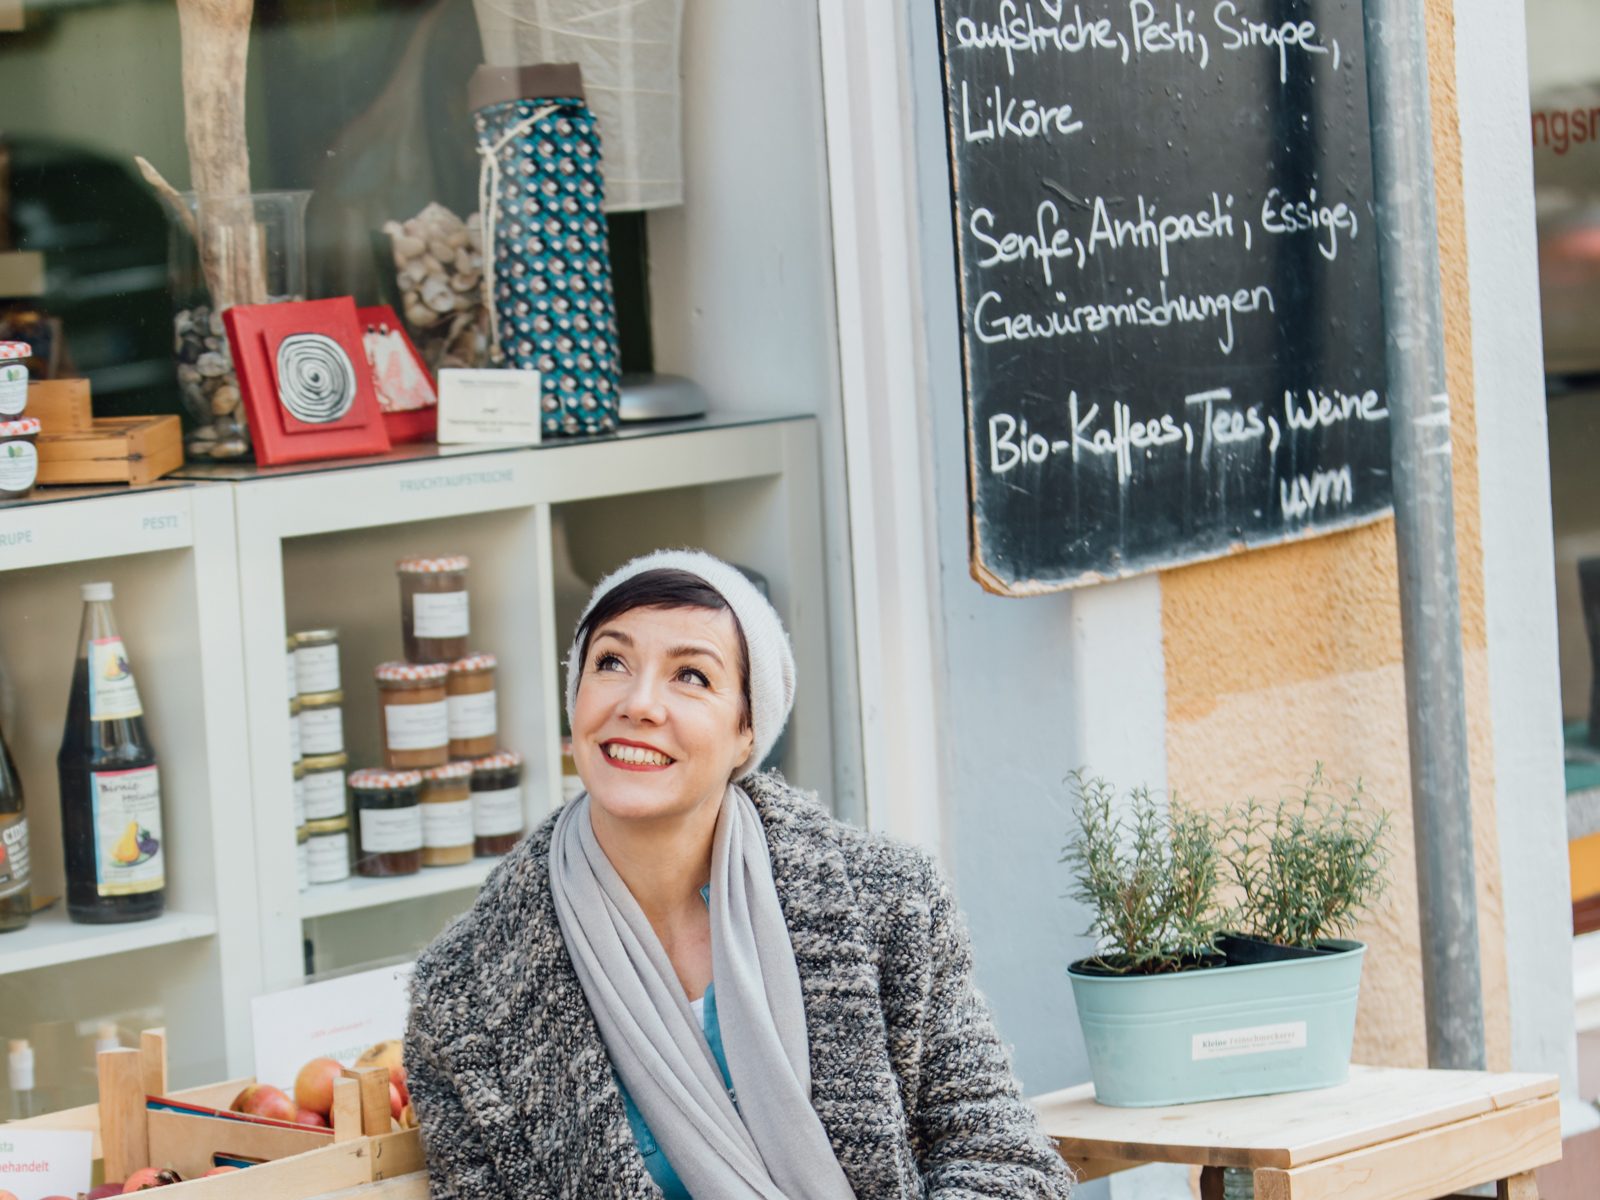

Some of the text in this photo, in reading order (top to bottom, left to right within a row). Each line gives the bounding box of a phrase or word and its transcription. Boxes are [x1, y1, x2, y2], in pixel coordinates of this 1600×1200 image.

[1213, 1, 1340, 84] Sirupe,
[969, 200, 1086, 286] Senfe,
[1088, 193, 1250, 277] Antipasti,
[972, 281, 1275, 355] Gewürzmischungen
[1184, 387, 1280, 458] Tees,
[1283, 388, 1389, 431] Weine
[142, 515, 179, 530] PESTI
[1279, 465, 1353, 520] uvm
